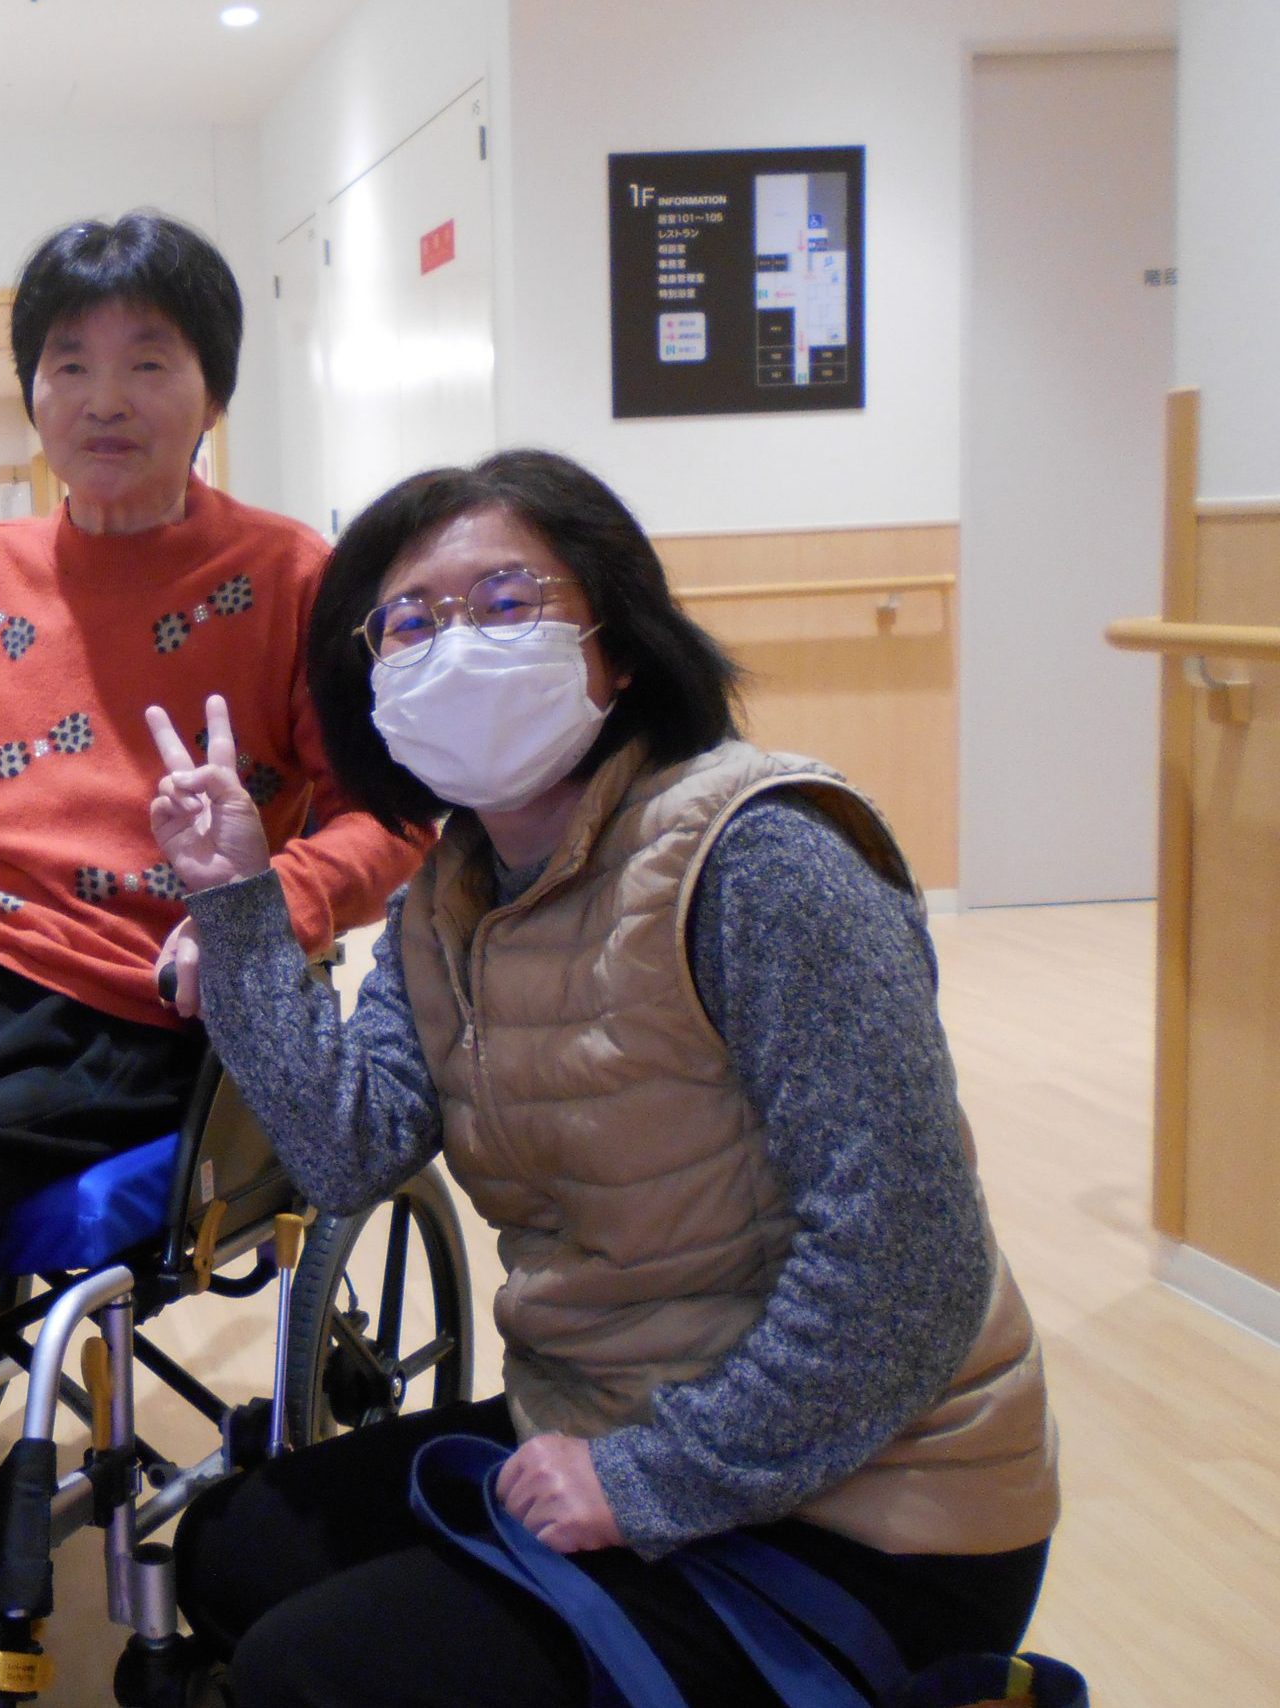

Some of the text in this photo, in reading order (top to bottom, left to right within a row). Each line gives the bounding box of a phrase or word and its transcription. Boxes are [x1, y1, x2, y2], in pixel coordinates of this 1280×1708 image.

[629, 183, 728, 208] 1F INFORMATION
[657, 228, 700, 239] レストラン
